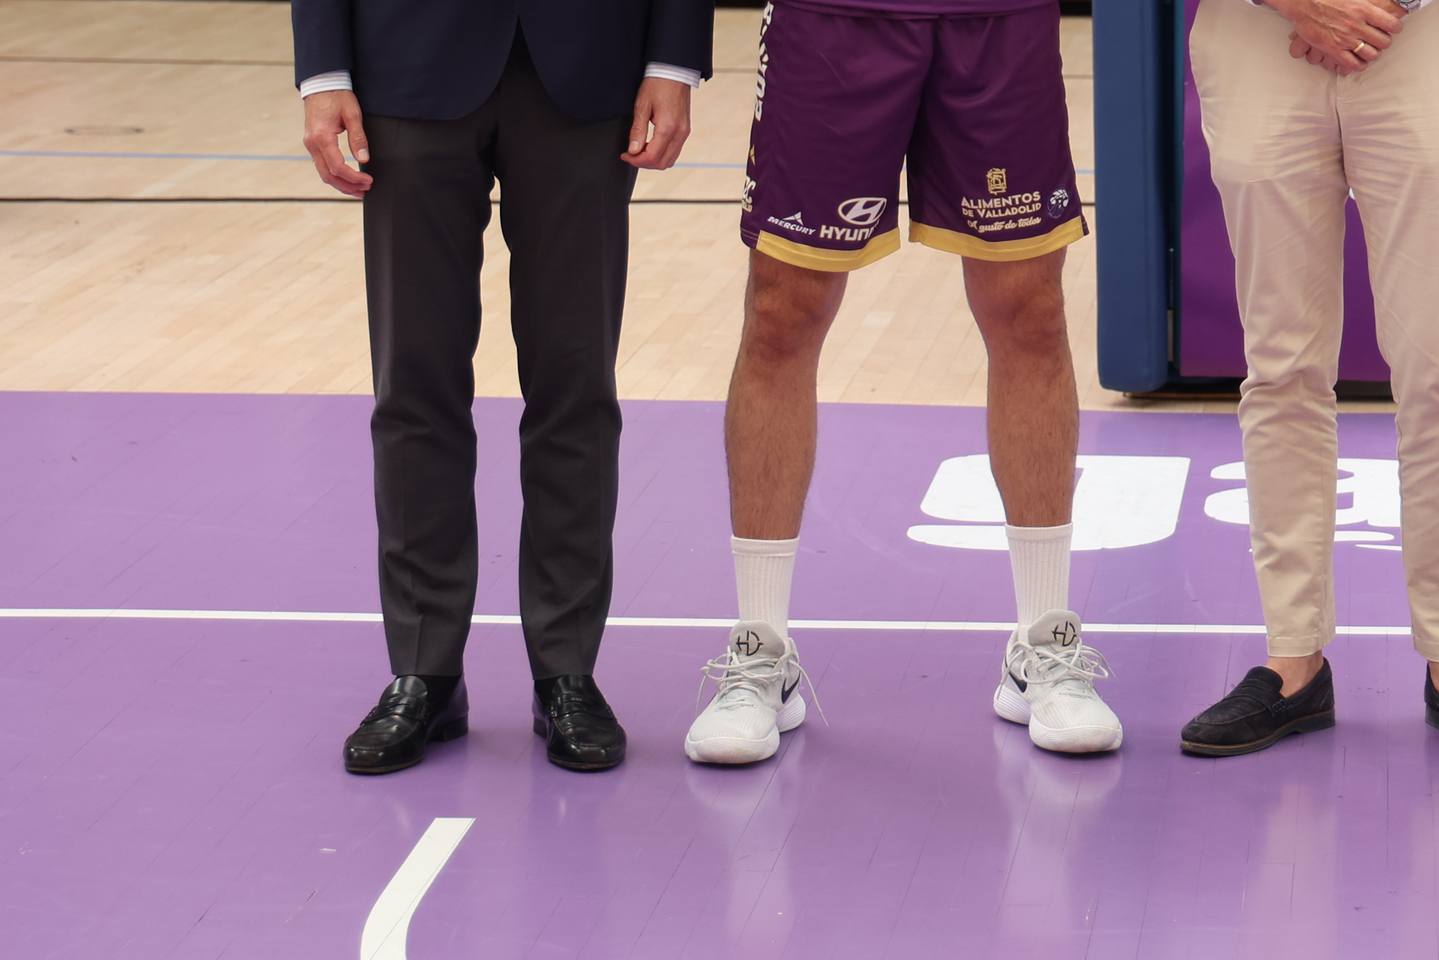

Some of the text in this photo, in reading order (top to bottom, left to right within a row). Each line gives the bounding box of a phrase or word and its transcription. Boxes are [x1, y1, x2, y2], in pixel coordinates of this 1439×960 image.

[961, 191, 1041, 209] ALIMENTOS
[962, 202, 1042, 219] DE VALLADOLID
[767, 215, 817, 236] MERCURY
[819, 221, 874, 242] HYUN
[978, 221, 1004, 233] gusto
